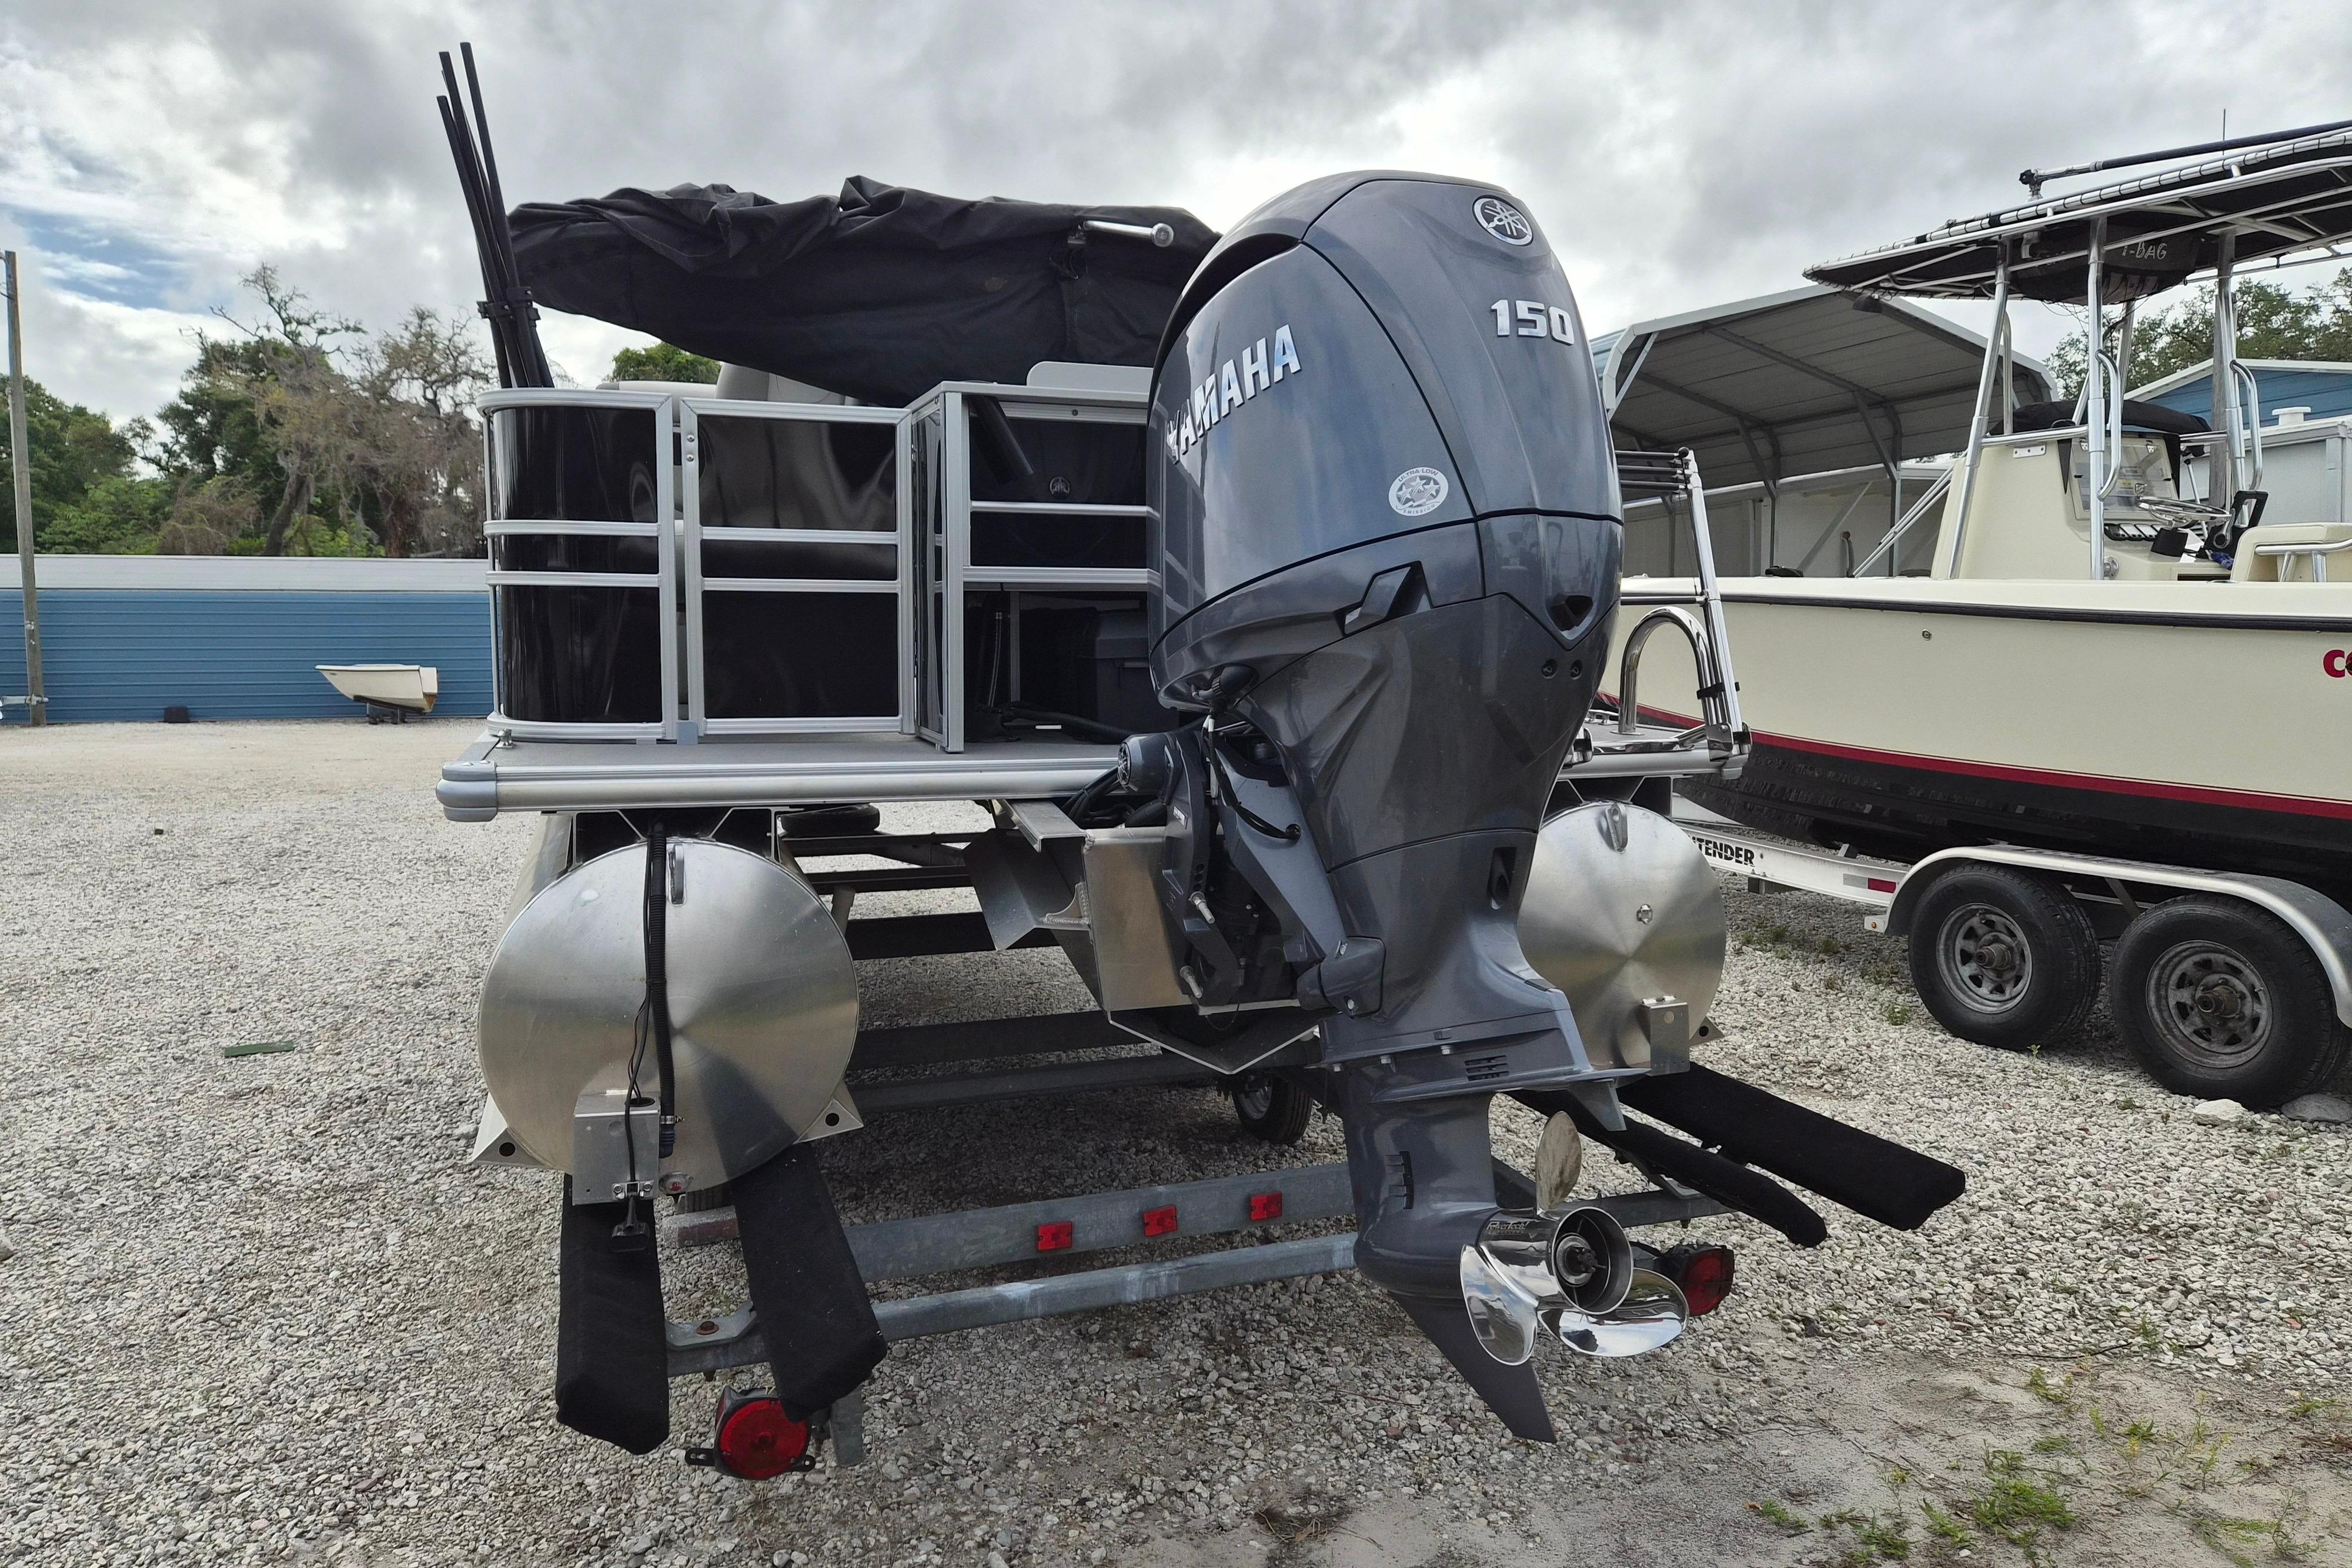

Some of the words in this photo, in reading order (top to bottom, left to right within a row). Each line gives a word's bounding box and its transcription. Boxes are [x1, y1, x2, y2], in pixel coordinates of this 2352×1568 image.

[1491, 299, 1575, 346] 150
[1167, 324, 1302, 464] YAMAHA
[1404, 503, 1435, 514] EMISSION
